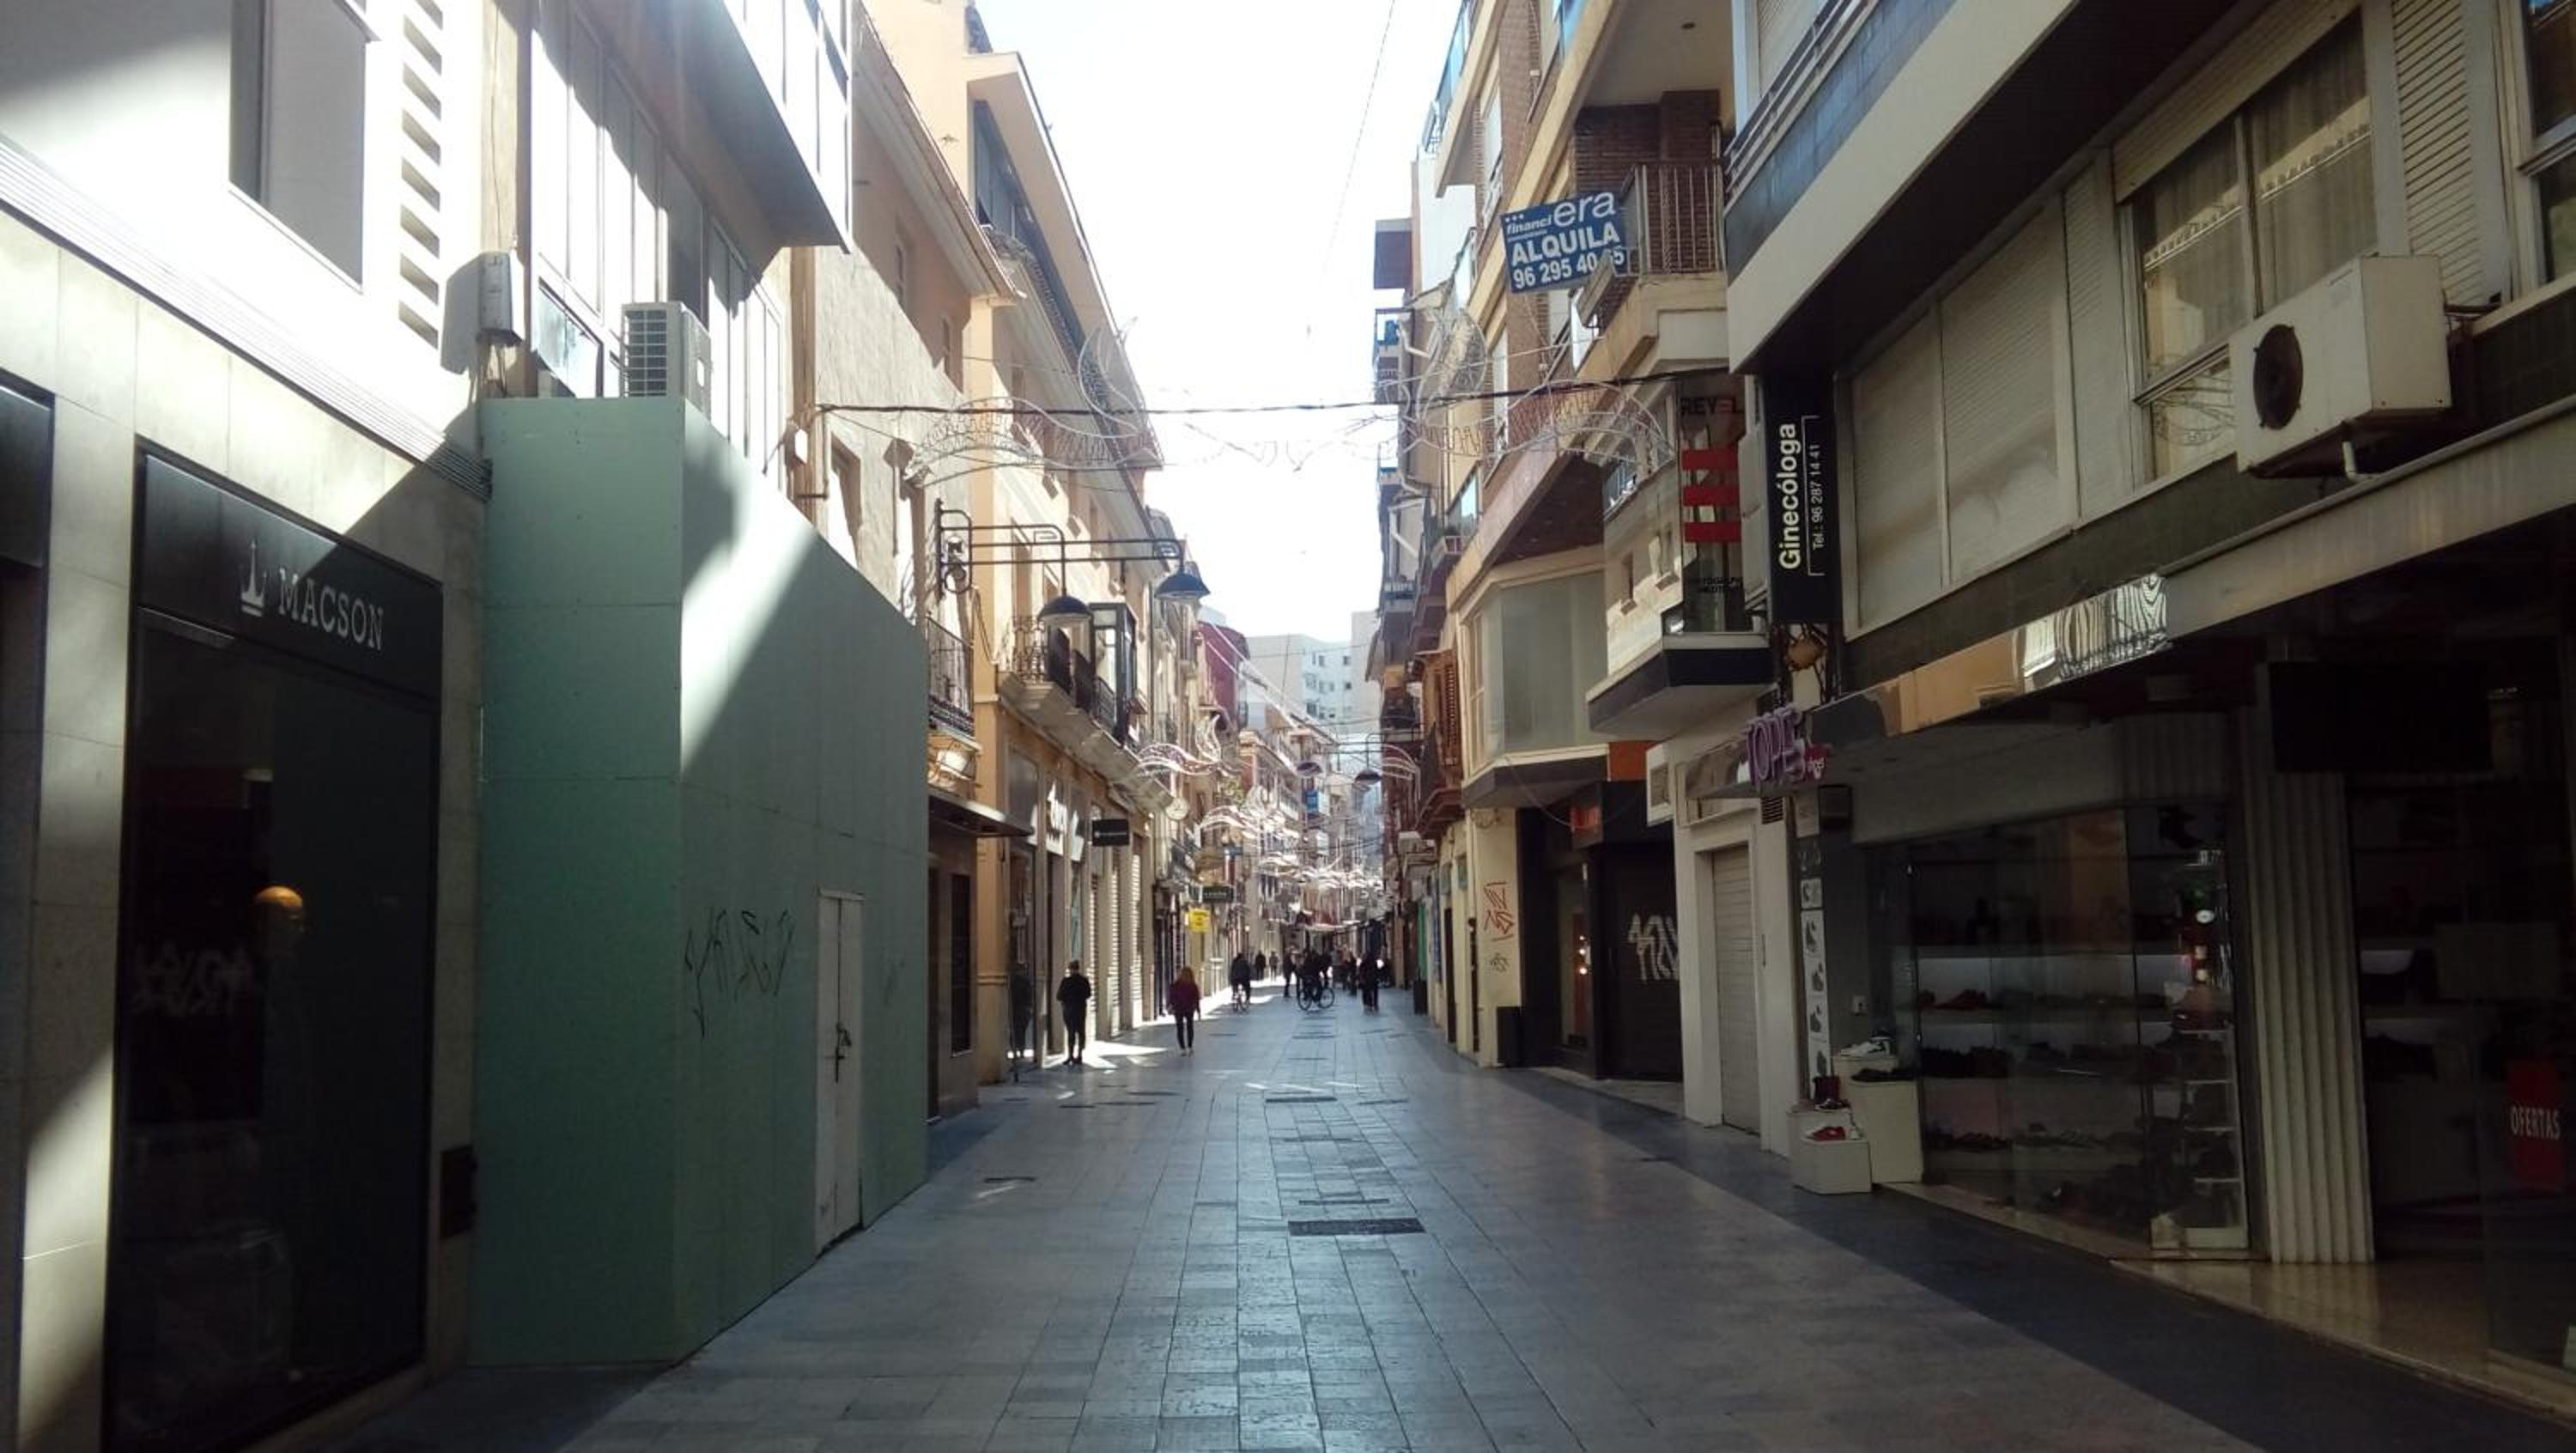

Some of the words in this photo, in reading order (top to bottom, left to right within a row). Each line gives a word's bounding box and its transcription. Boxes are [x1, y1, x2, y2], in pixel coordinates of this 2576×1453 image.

[1511, 221, 1620, 267] ALQUILA
[1513, 267, 1536, 289] 96
[1539, 258, 1573, 283] 295
[1576, 252, 1598, 274] 40
[1776, 423, 1802, 570] Ginecóloga
[1809, 481, 1824, 504] 287
[1811, 508, 1824, 523] 96
[278, 566, 385, 651] MACSON
[2509, 1104, 2561, 1140] OFERTAS
